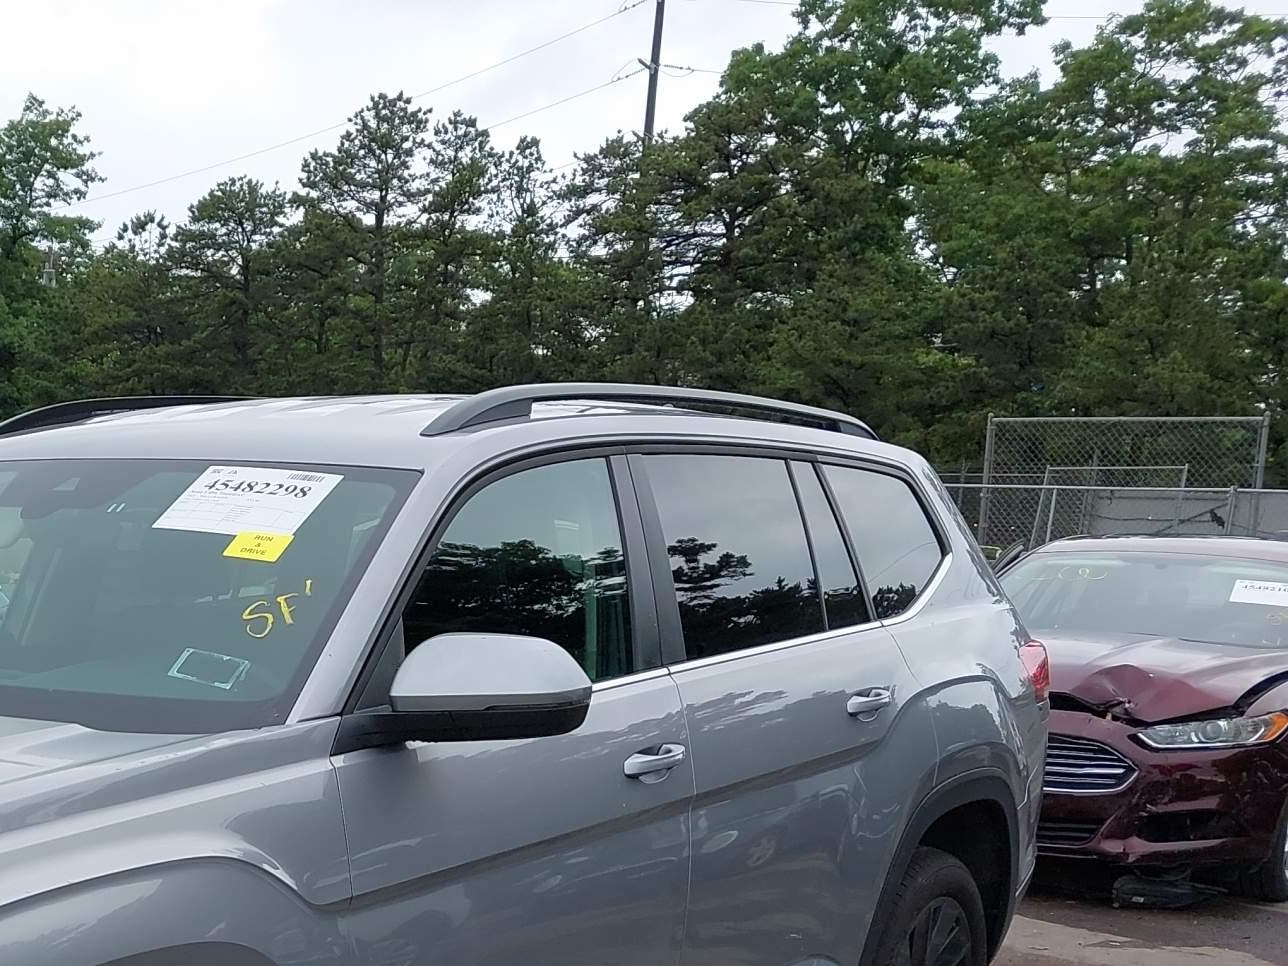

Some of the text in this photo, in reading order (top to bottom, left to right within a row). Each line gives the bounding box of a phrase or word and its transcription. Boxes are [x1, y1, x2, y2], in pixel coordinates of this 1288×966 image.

[203, 478, 312, 499] 45482298
[253, 534, 274, 542] RUN
[239, 547, 268, 556] DRIVE
